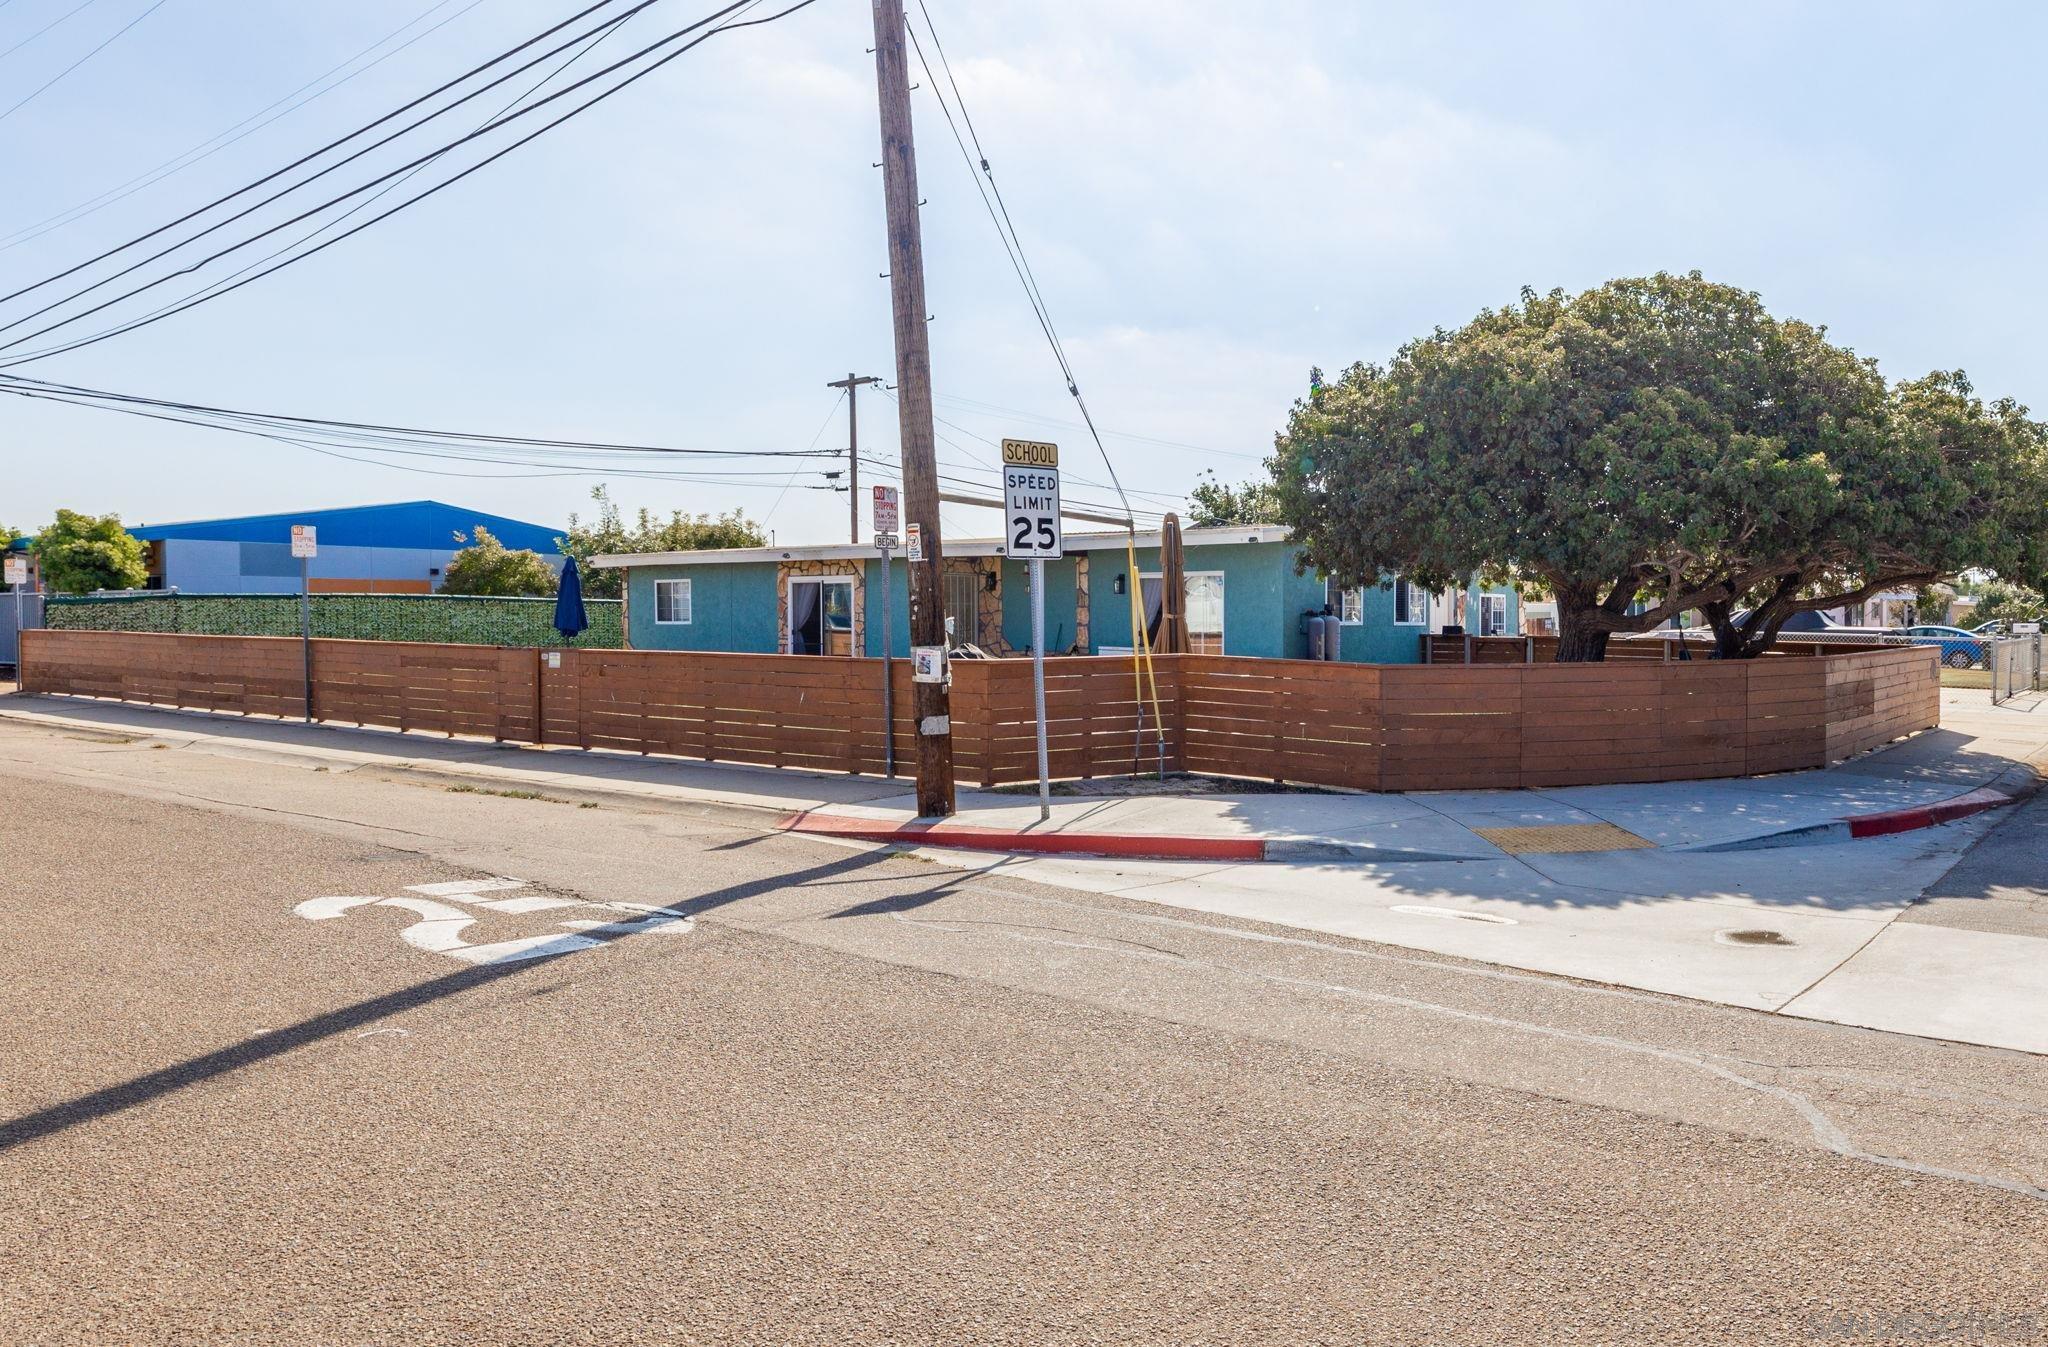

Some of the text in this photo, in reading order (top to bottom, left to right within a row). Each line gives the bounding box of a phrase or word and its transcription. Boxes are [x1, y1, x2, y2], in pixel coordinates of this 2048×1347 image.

[1006, 443, 1055, 464] SCHOOL
[1008, 474, 1056, 491] SPEED
[873, 487, 885, 500] NO
[875, 501, 897, 511] STOPPING
[1013, 496, 1052, 511] LIMIT
[1012, 516, 1056, 550] 25
[877, 537, 896, 547] BEGIN
